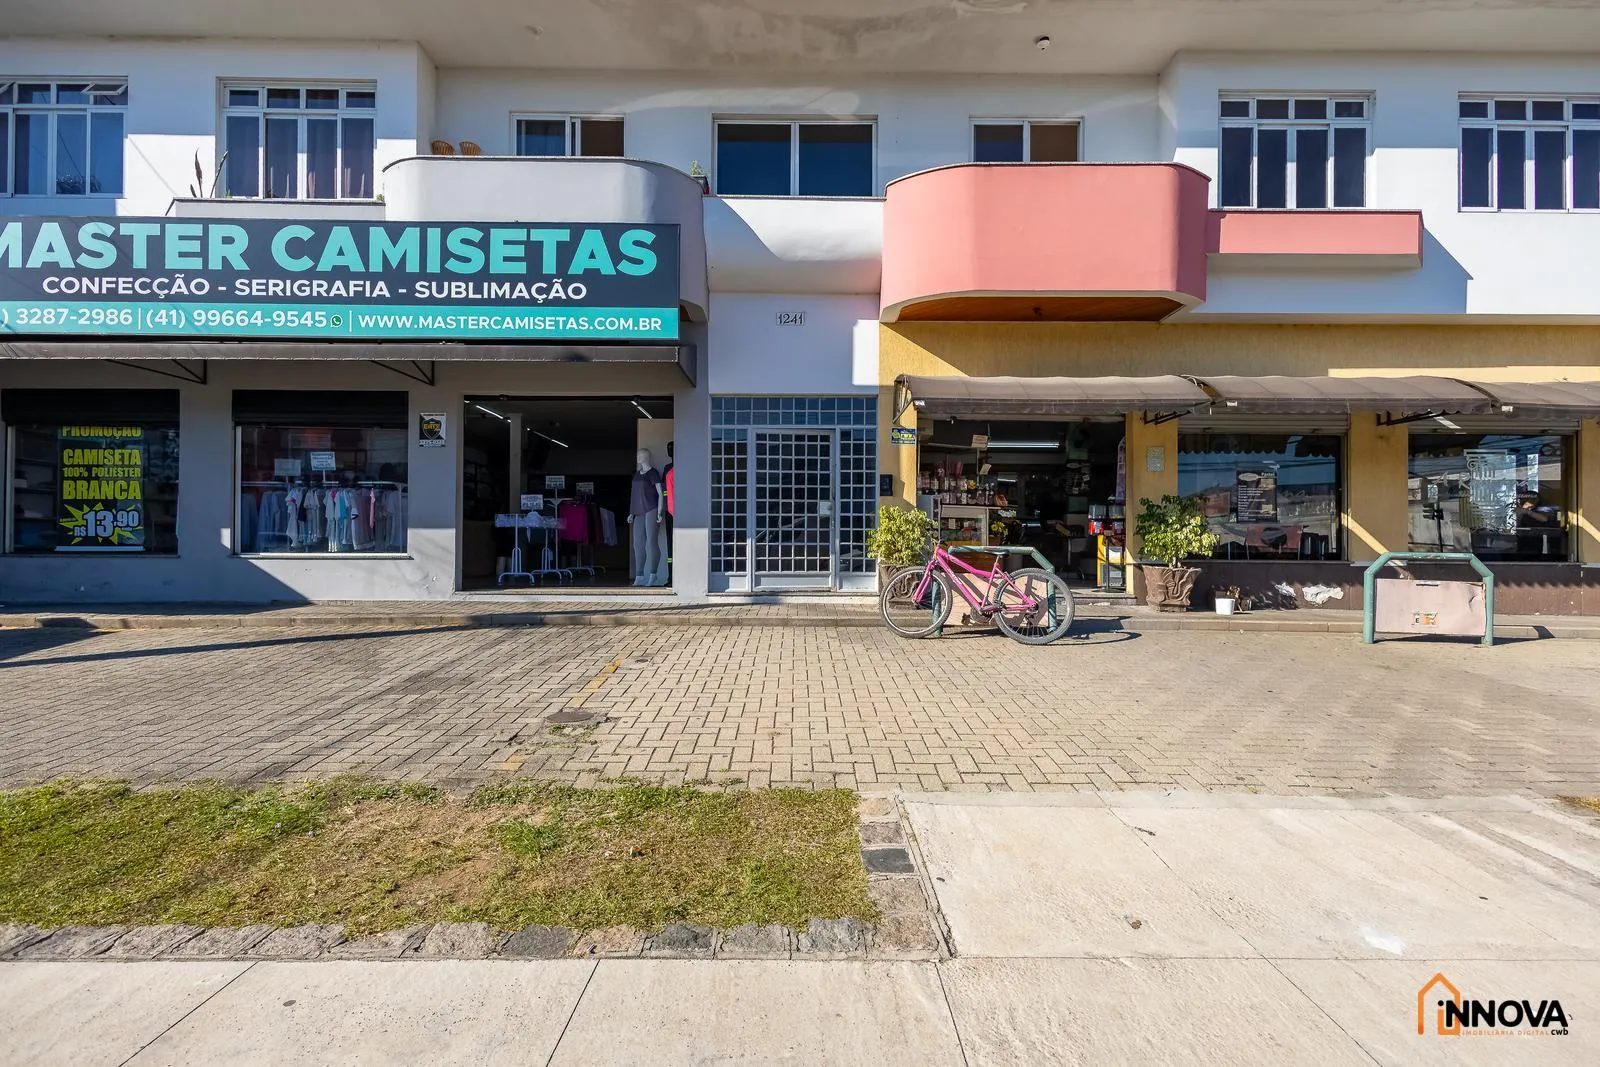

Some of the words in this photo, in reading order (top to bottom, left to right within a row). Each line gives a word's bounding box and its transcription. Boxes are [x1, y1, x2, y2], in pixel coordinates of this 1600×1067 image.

[270, 225, 657, 275] CAMISETAS
[42, 274, 211, 299] CONFECÇÃO
[234, 278, 391, 298] SERIGRAFIA
[414, 278, 588, 303] SUBLIMAÇÃO
[15, 308, 133, 326] 3287-2986
[145, 308, 187, 330] (41)
[193, 309, 328, 329] 99664-9545
[357, 314, 662, 332] WWW.MASTERCAMISETAS.COM.BR
[778, 313, 803, 325] 1241
[63, 449, 141, 465] CAMISETA
[63, 467, 88, 477] 100%
[63, 480, 141, 500] BRANCA
